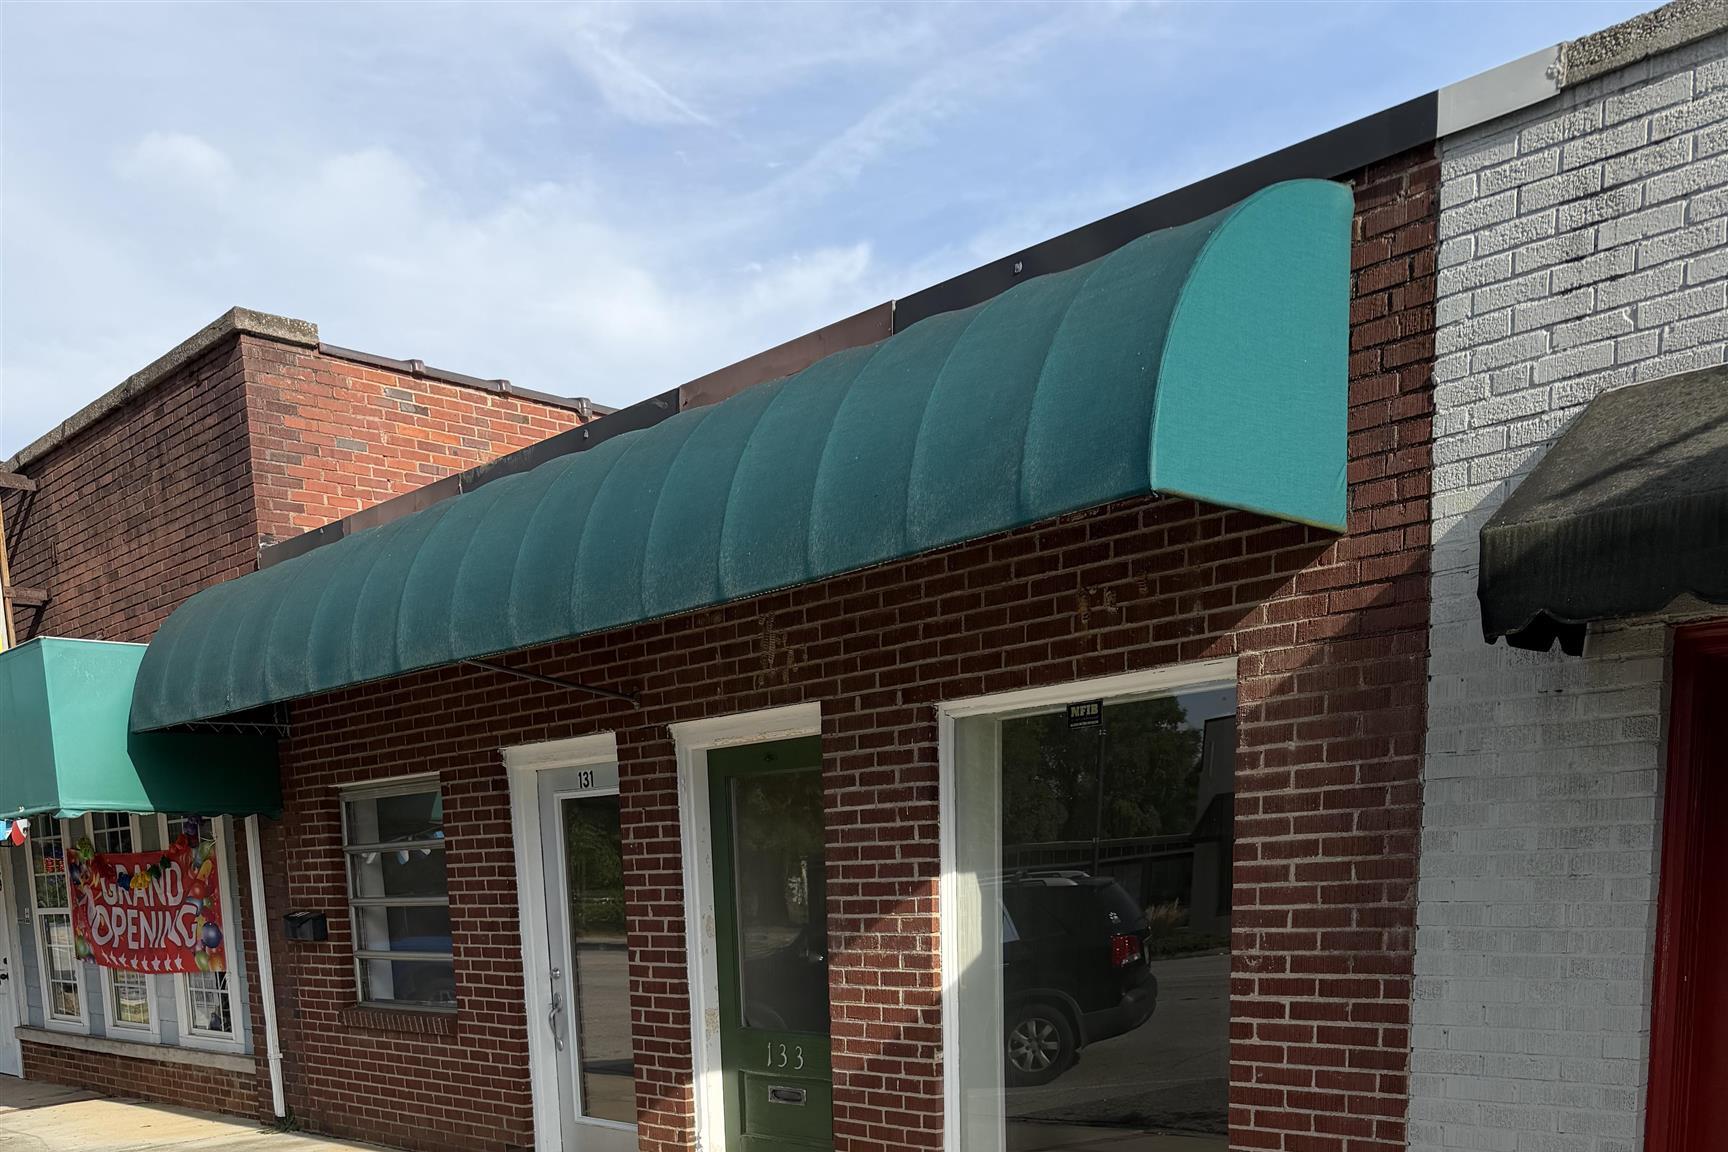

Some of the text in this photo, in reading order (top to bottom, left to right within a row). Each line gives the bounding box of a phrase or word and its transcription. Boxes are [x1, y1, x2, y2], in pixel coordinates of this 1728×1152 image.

[1070, 703, 1099, 718] NFIB
[578, 770, 594, 788] 131
[91, 904, 198, 949] OPENING
[767, 1042, 804, 1070] 133
